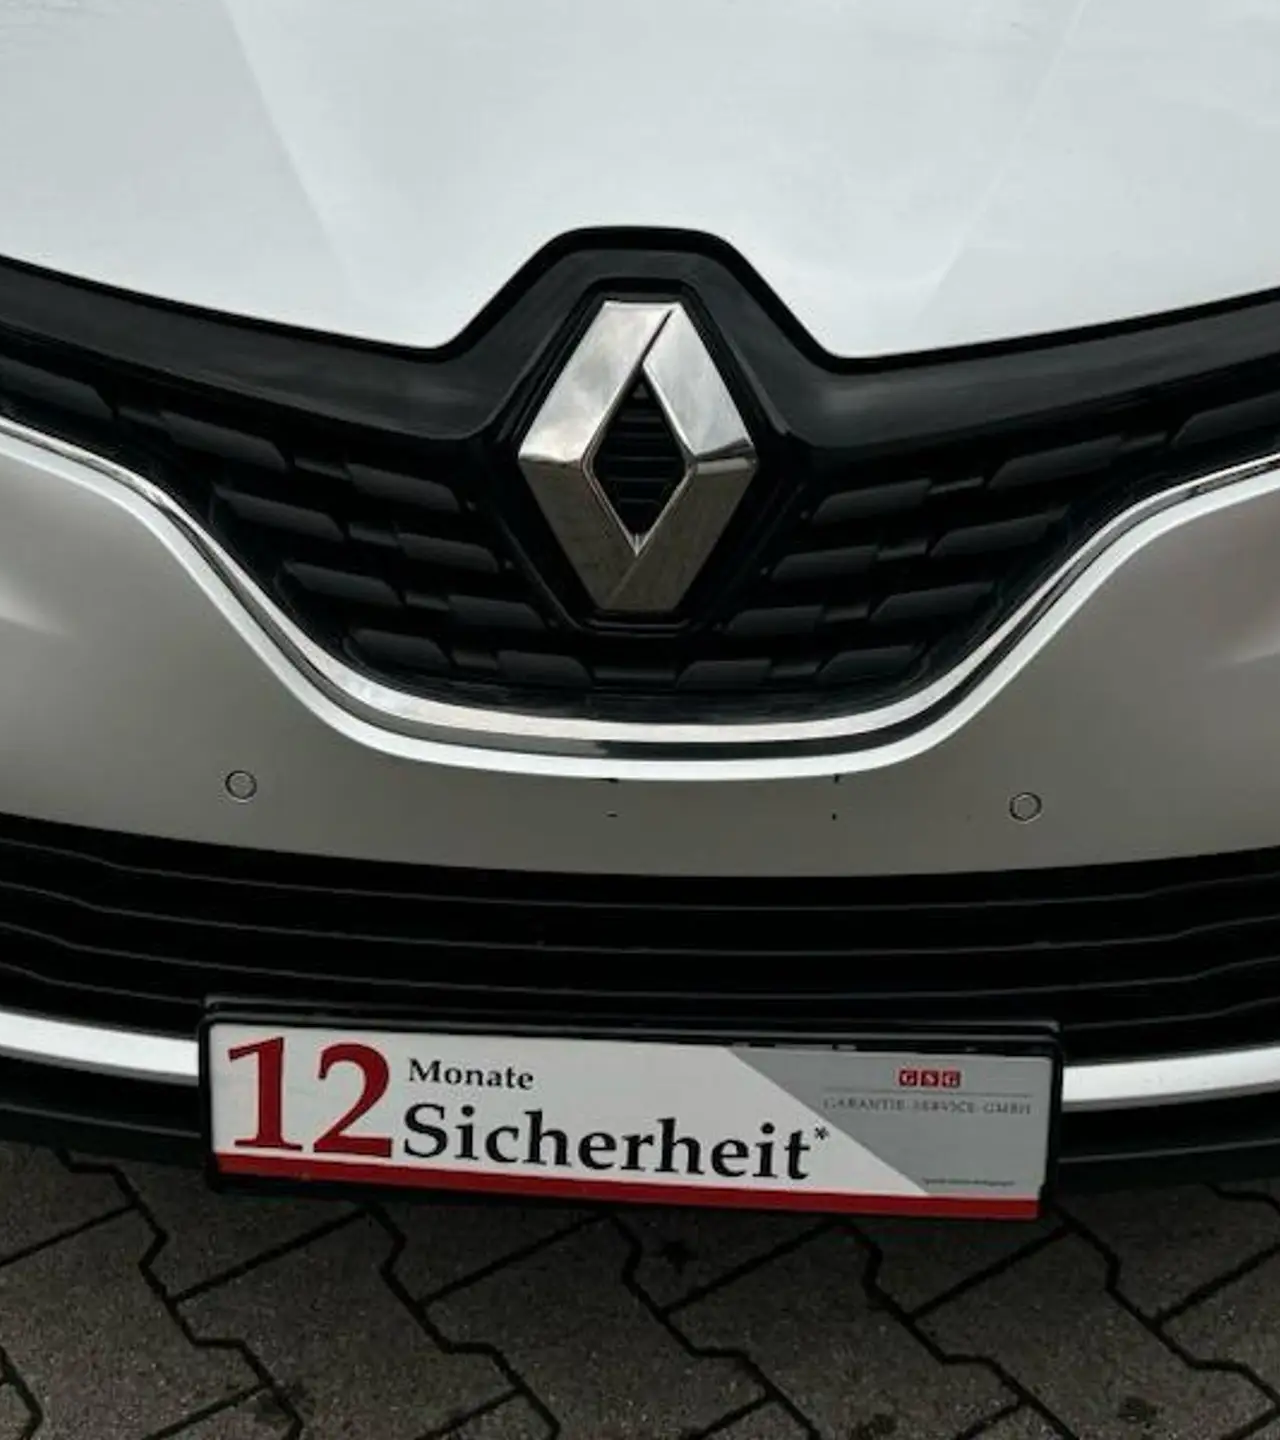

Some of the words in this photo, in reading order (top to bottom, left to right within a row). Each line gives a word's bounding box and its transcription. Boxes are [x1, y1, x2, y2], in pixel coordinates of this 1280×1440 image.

[408, 1058, 534, 1090] Monate
[899, 1069, 961, 1088] GSG
[228, 1036, 393, 1158] 12
